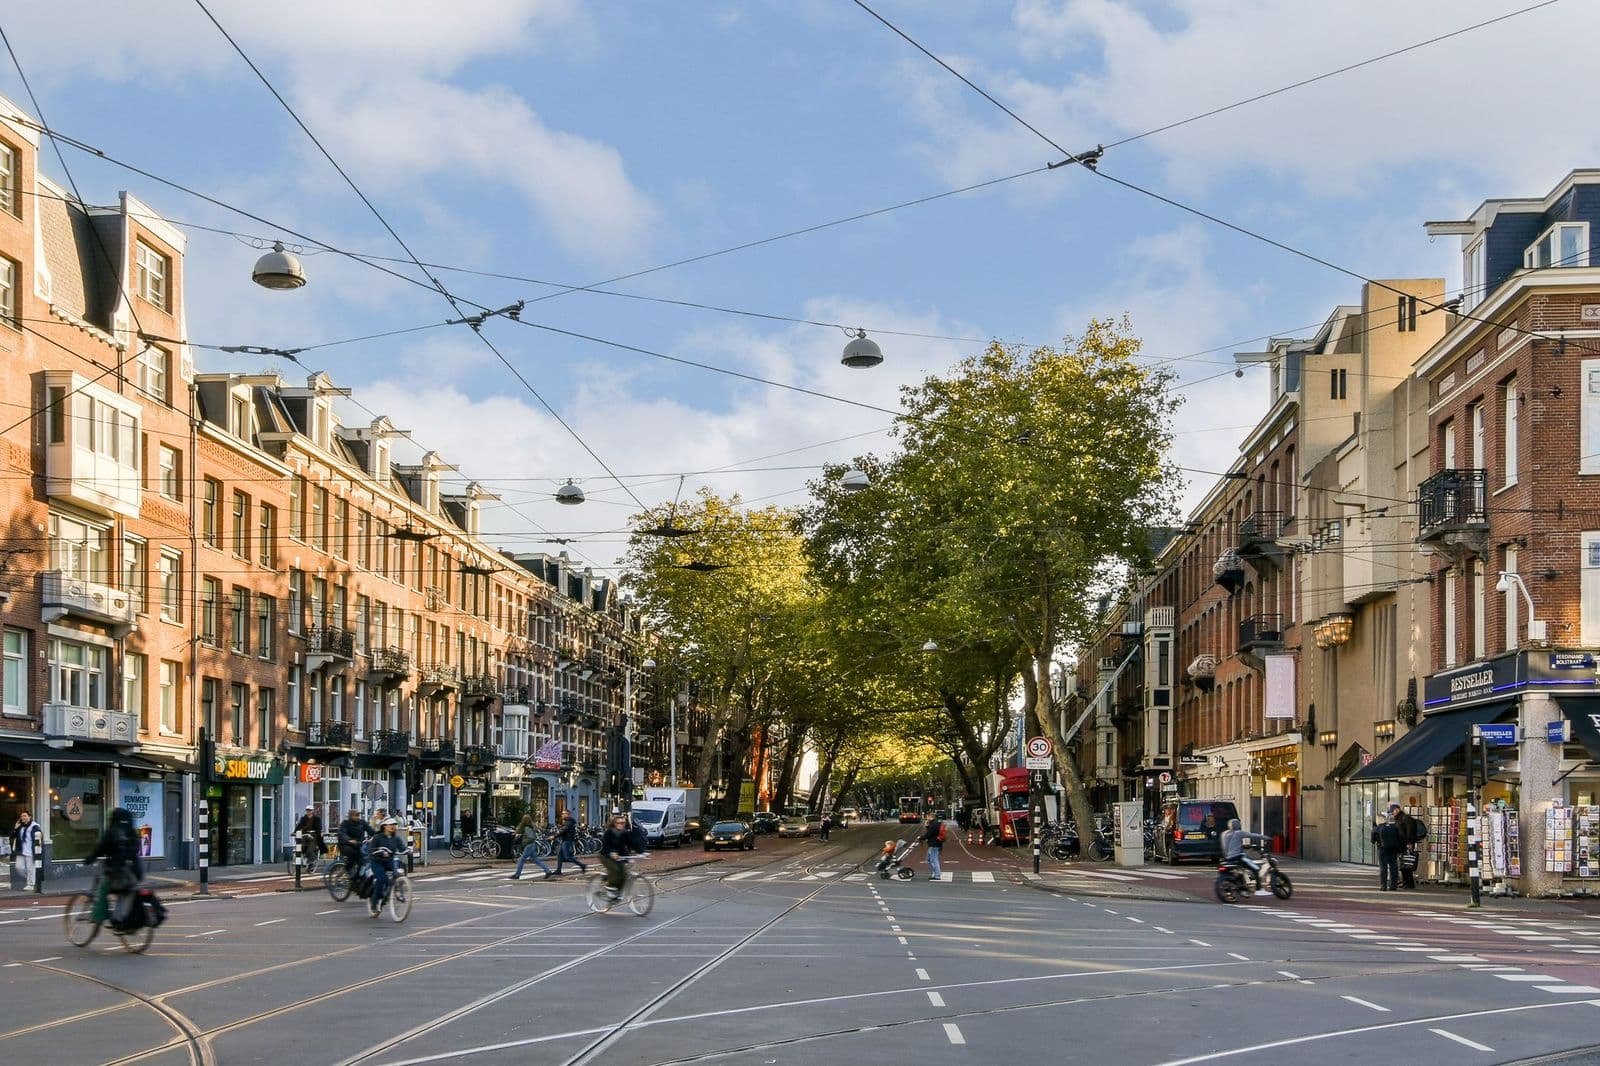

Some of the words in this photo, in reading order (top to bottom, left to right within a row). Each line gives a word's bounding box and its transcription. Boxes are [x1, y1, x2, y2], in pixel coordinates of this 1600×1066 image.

[1451, 669, 1494, 692] BESTSELLER
[1032, 743, 1047, 751] 30
[227, 760, 271, 778] SUBWAY
